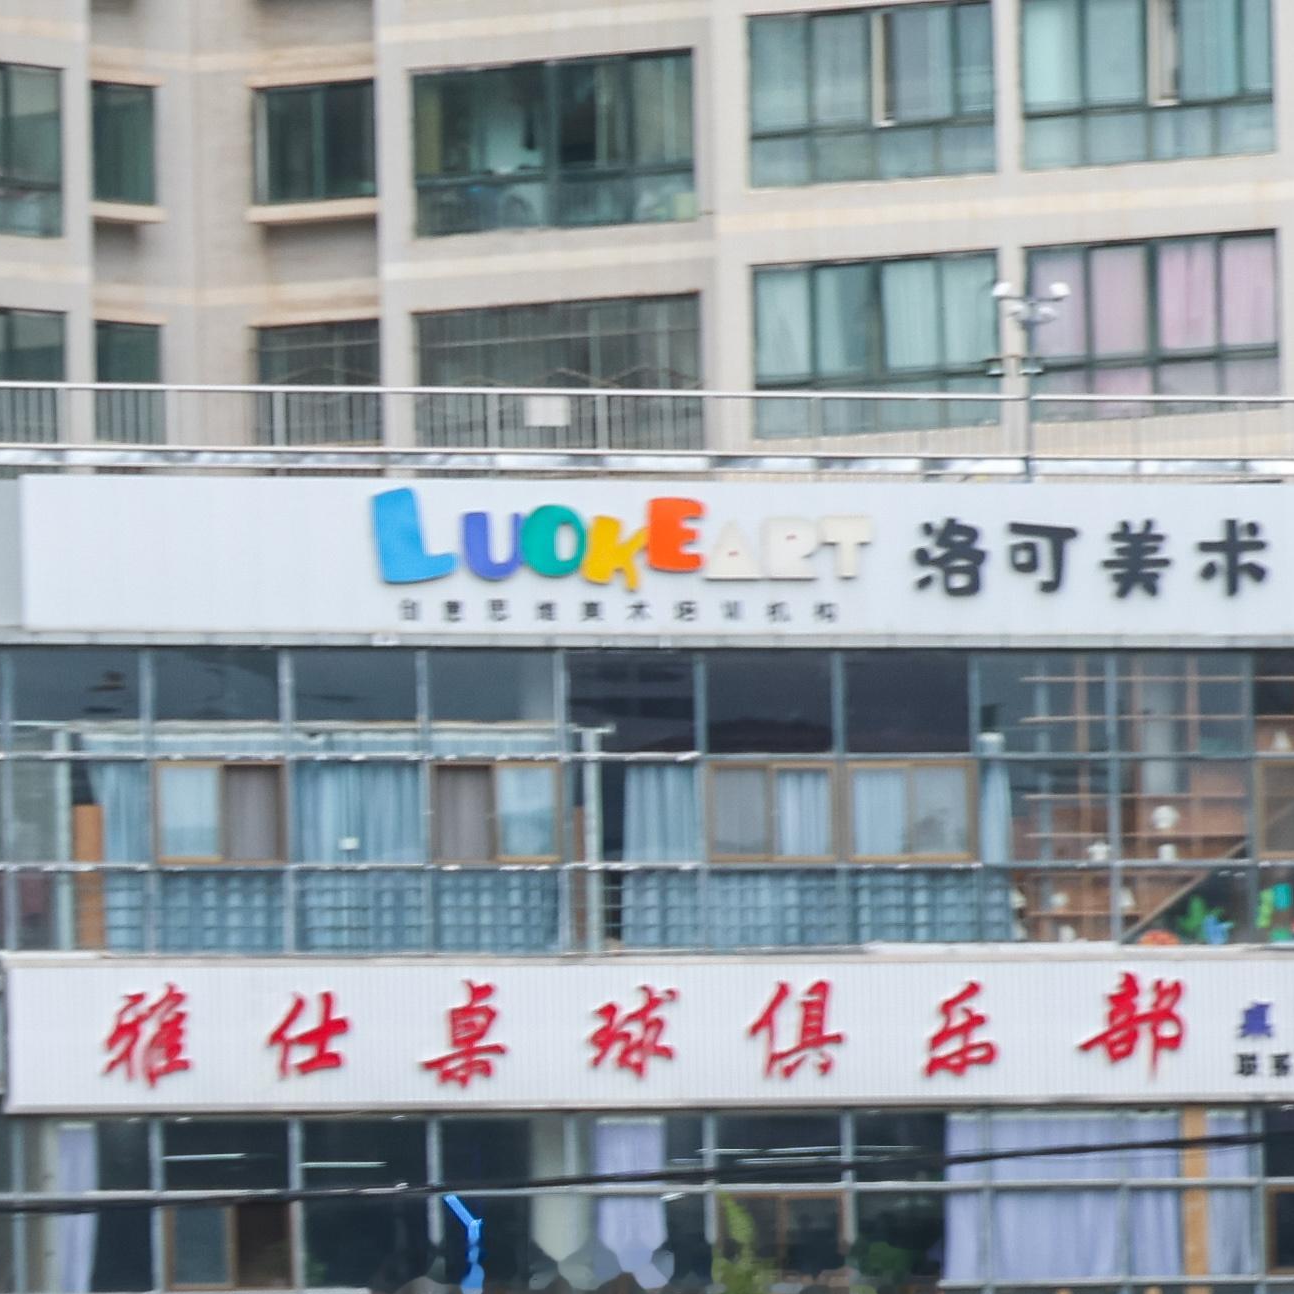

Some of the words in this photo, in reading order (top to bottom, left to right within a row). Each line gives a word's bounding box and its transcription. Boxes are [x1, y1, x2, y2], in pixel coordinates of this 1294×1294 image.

[914, 518, 1268, 598] 洛可美术
[103, 971, 1186, 1088] 雅仕桌球俱乐部
